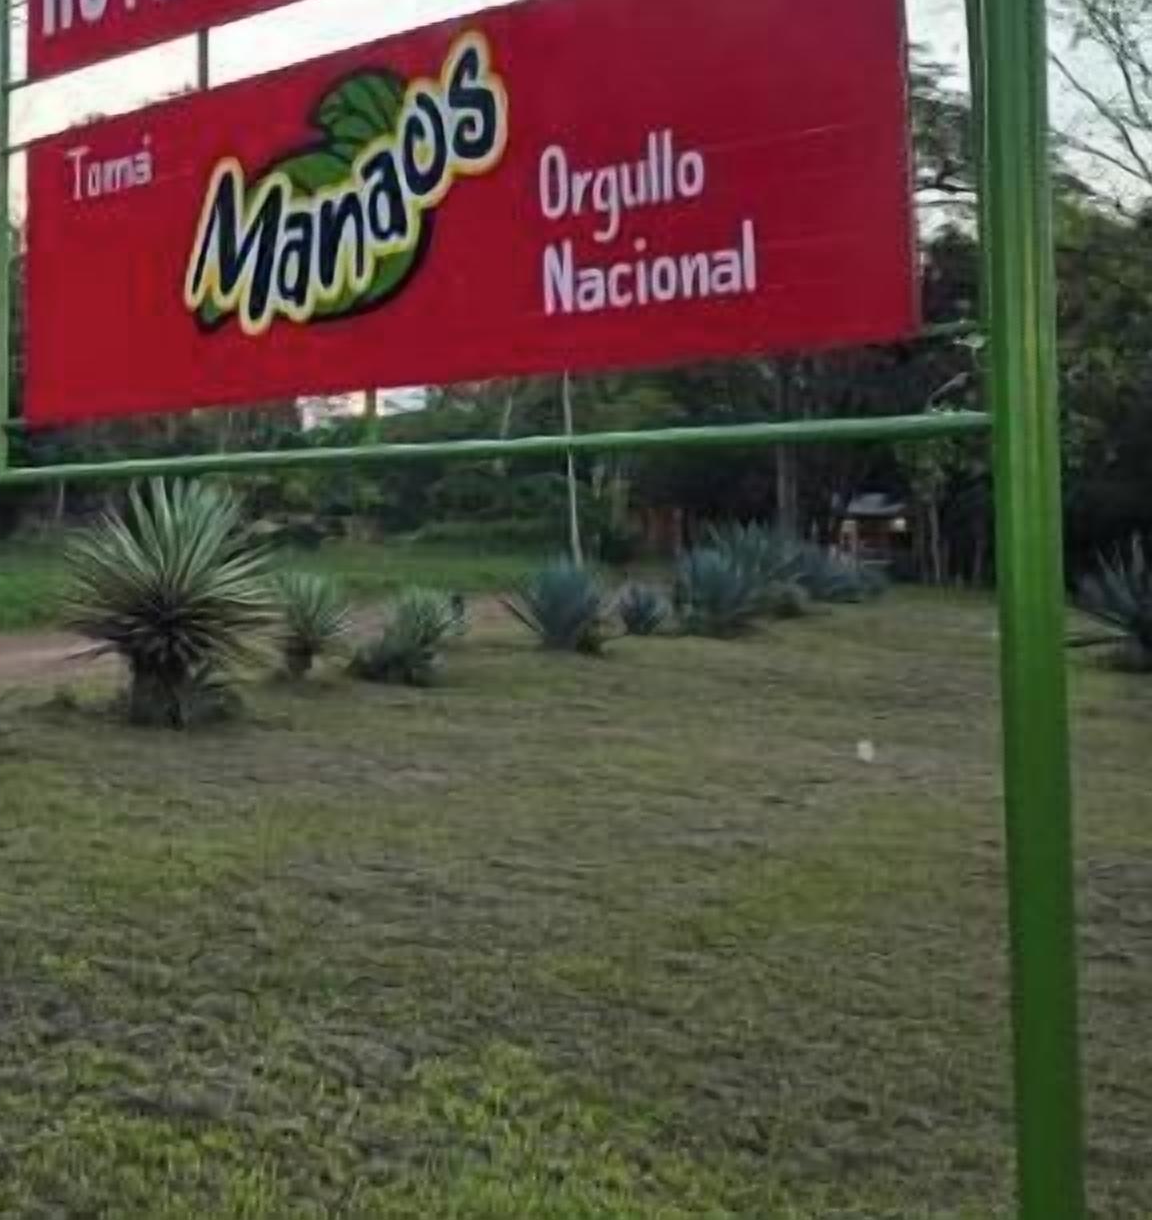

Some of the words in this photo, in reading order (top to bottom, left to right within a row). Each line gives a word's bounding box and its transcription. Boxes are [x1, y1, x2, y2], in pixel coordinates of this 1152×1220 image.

[186, 34, 506, 332] Manaos
[539, 130, 705, 242] Orgullo
[543, 221, 757, 316] Nacional
